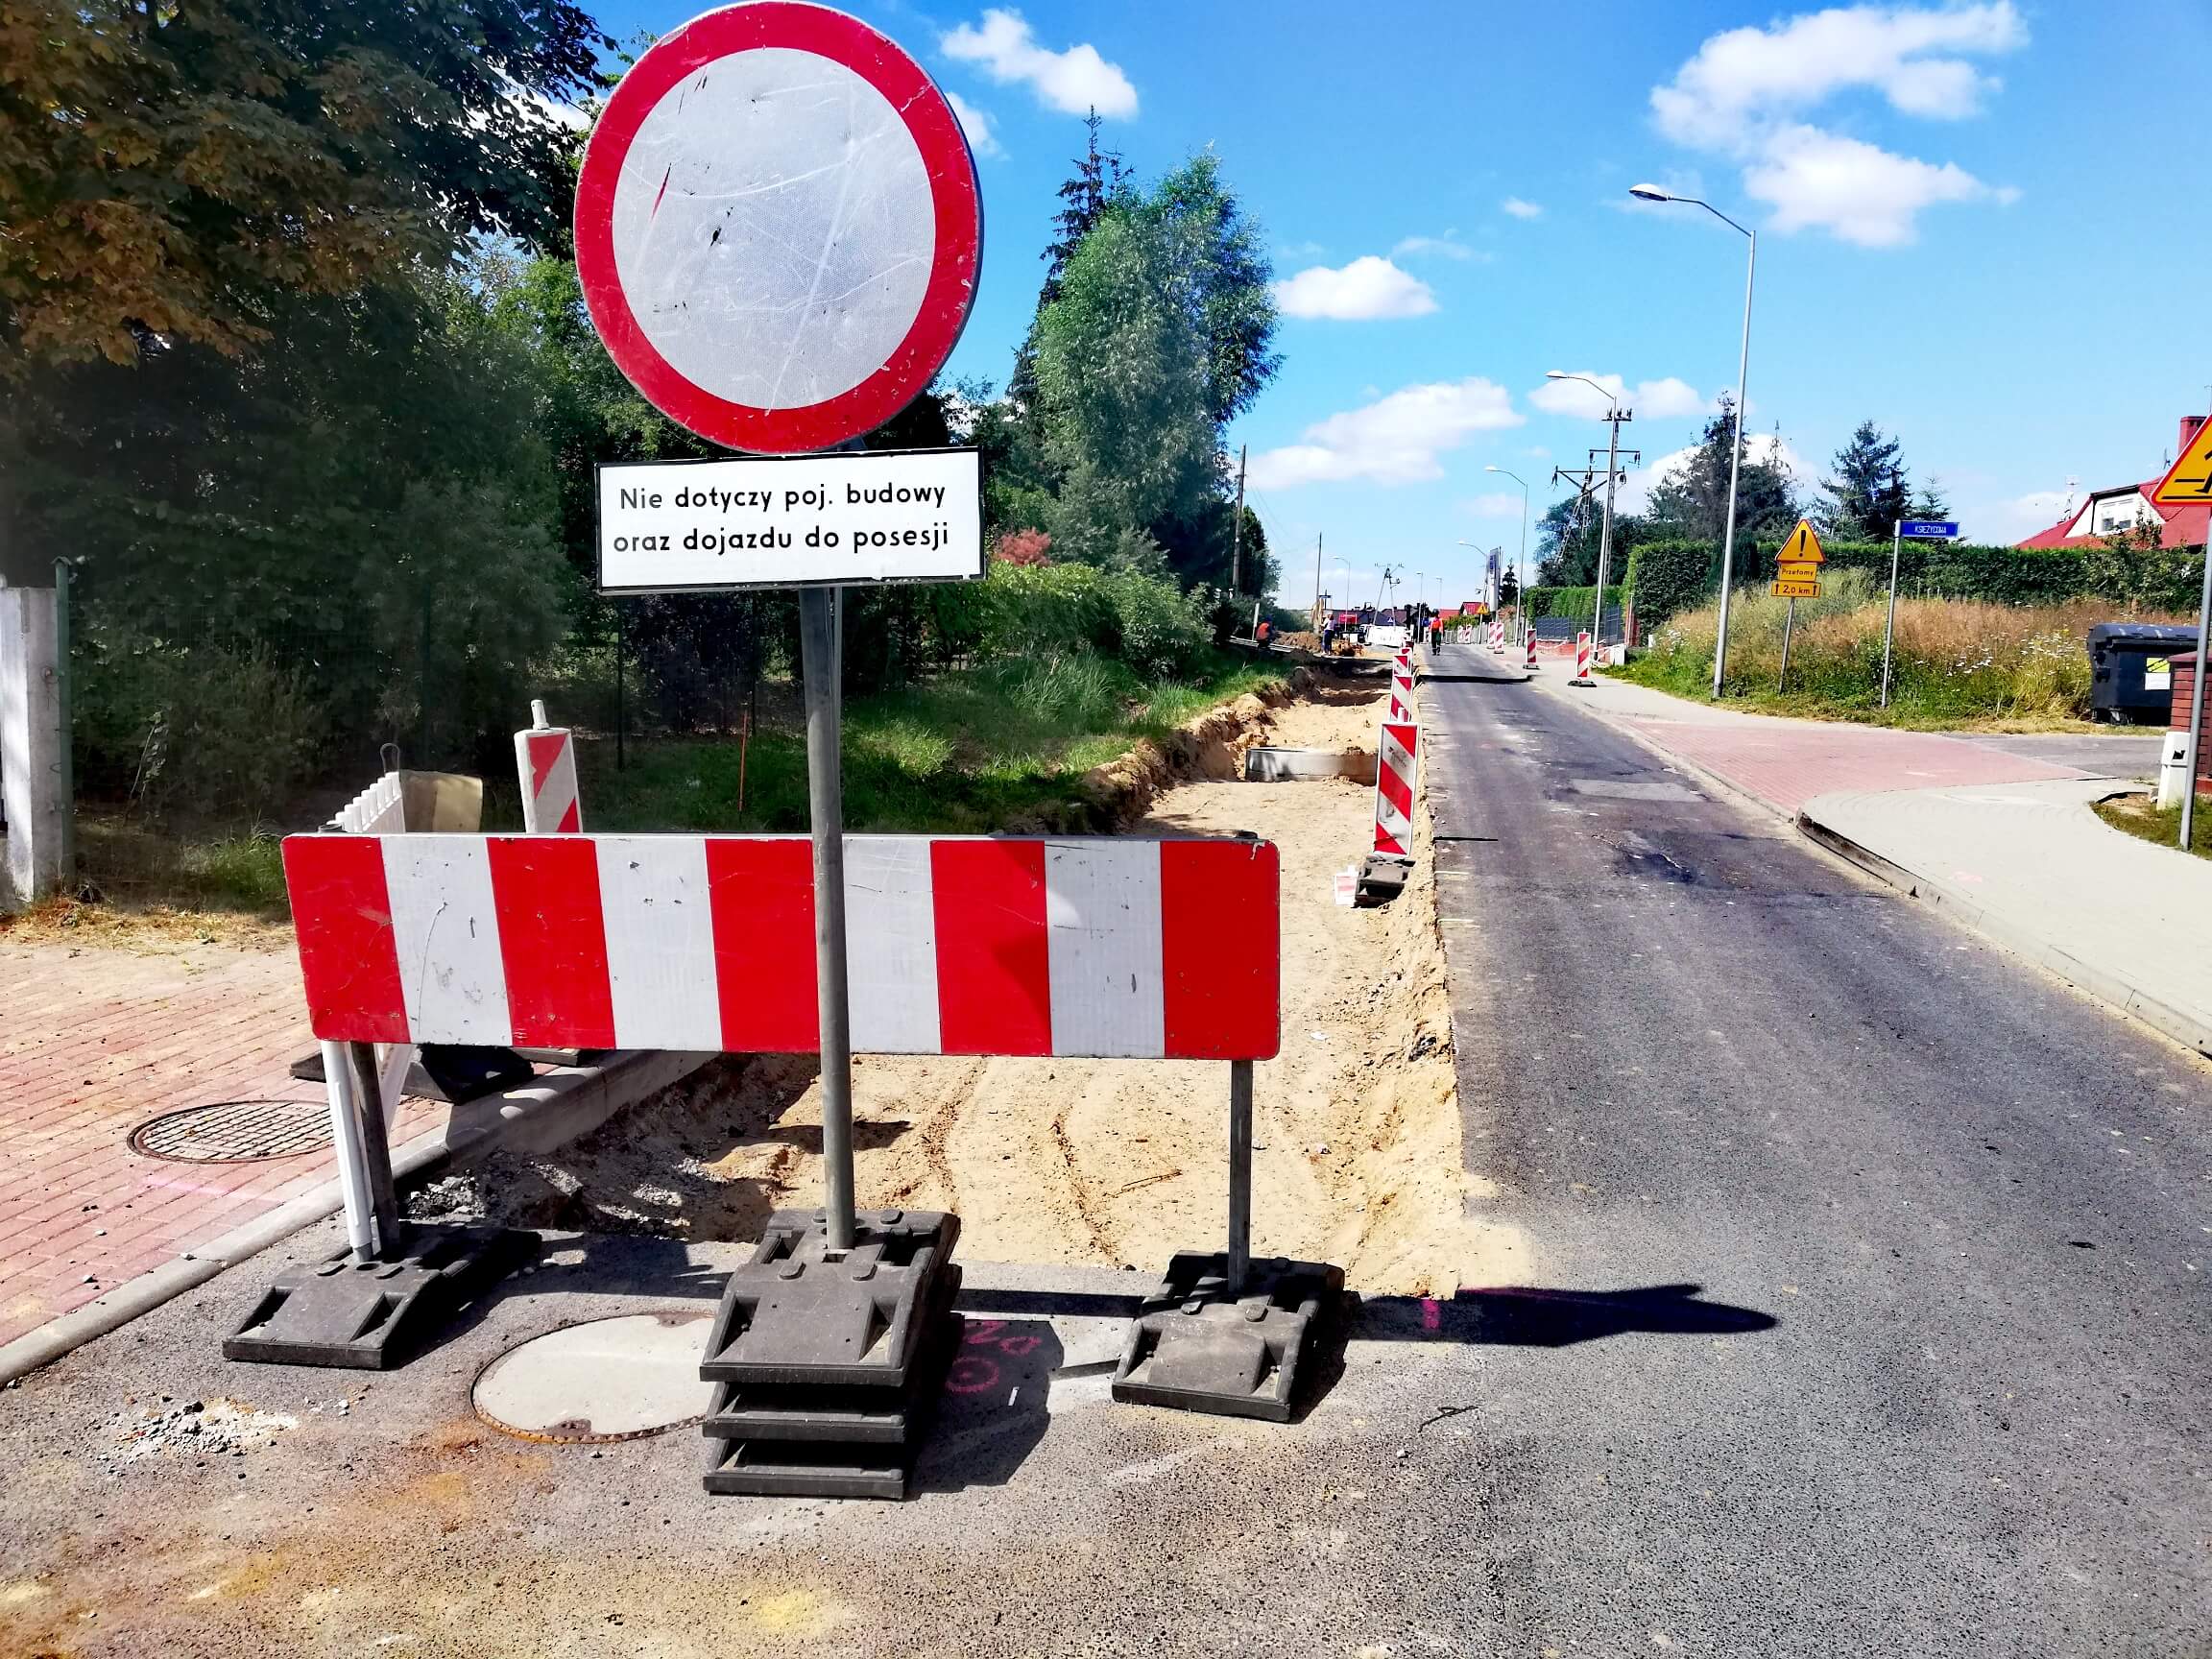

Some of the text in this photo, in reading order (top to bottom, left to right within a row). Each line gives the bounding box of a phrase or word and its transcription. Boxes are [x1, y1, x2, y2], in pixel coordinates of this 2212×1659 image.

[620, 482, 946, 514] Nie dotyczy poj. budowy
[613, 521, 949, 555] oraz dojazdu do posesji
[1782, 585, 1796, 594] 2,0
